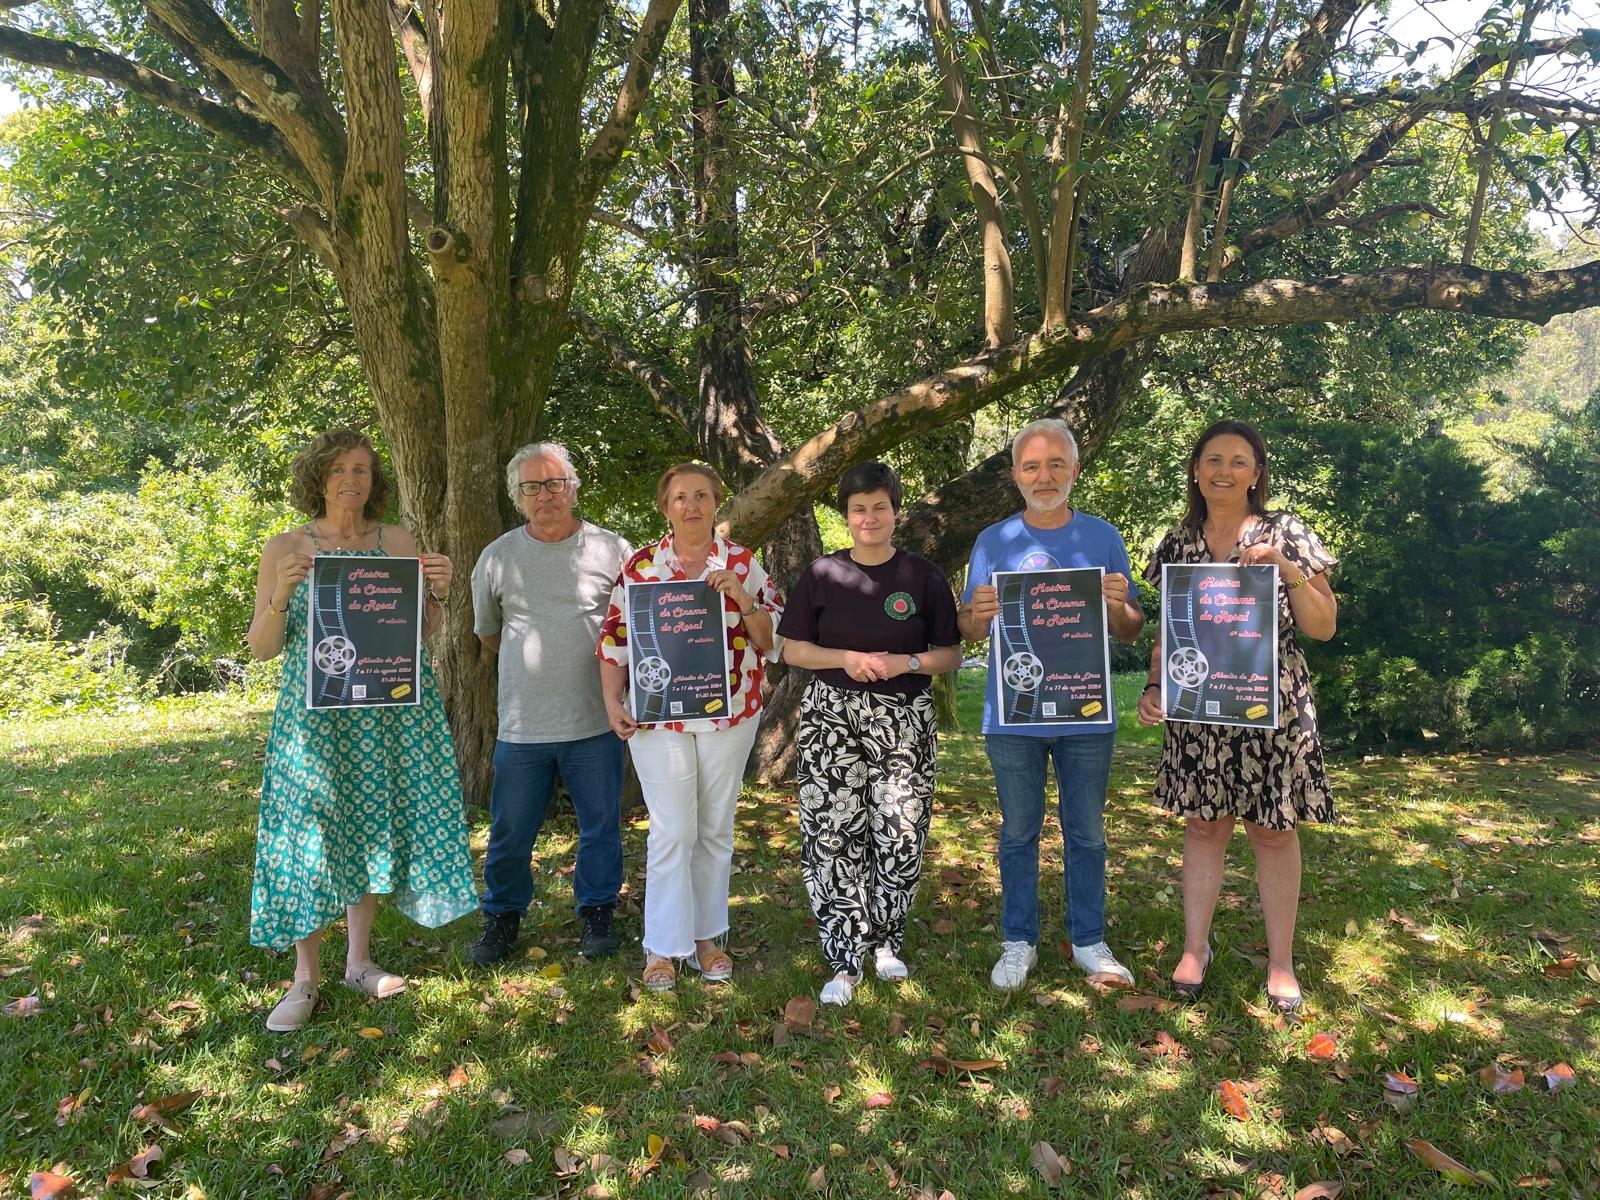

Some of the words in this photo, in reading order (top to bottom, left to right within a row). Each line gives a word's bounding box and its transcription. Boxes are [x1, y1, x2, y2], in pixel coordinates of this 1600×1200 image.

[348, 568, 390, 581] Mostra
[349, 584, 361, 593] de
[364, 584, 402, 595] Cinema
[1030, 582, 1071, 596] Mostra
[1199, 576, 1240, 590] Mostra
[658, 592, 694, 605] Mostra
[1032, 599, 1044, 609] de
[1046, 598, 1086, 610] Cinema
[1200, 593, 1212, 604] de
[1214, 593, 1256, 606] Cinema
[348, 600, 361, 609] do
[363, 600, 397, 612] Rosal
[660, 608, 670, 618] de
[673, 606, 707, 618] Cinema
[1032, 615, 1045, 625] do
[1047, 612, 1080, 628] Rosal
[1200, 610, 1212, 620] do
[1214, 610, 1250, 624] Rosal
[661, 622, 672, 632] do
[673, 620, 703, 633] Rosal
